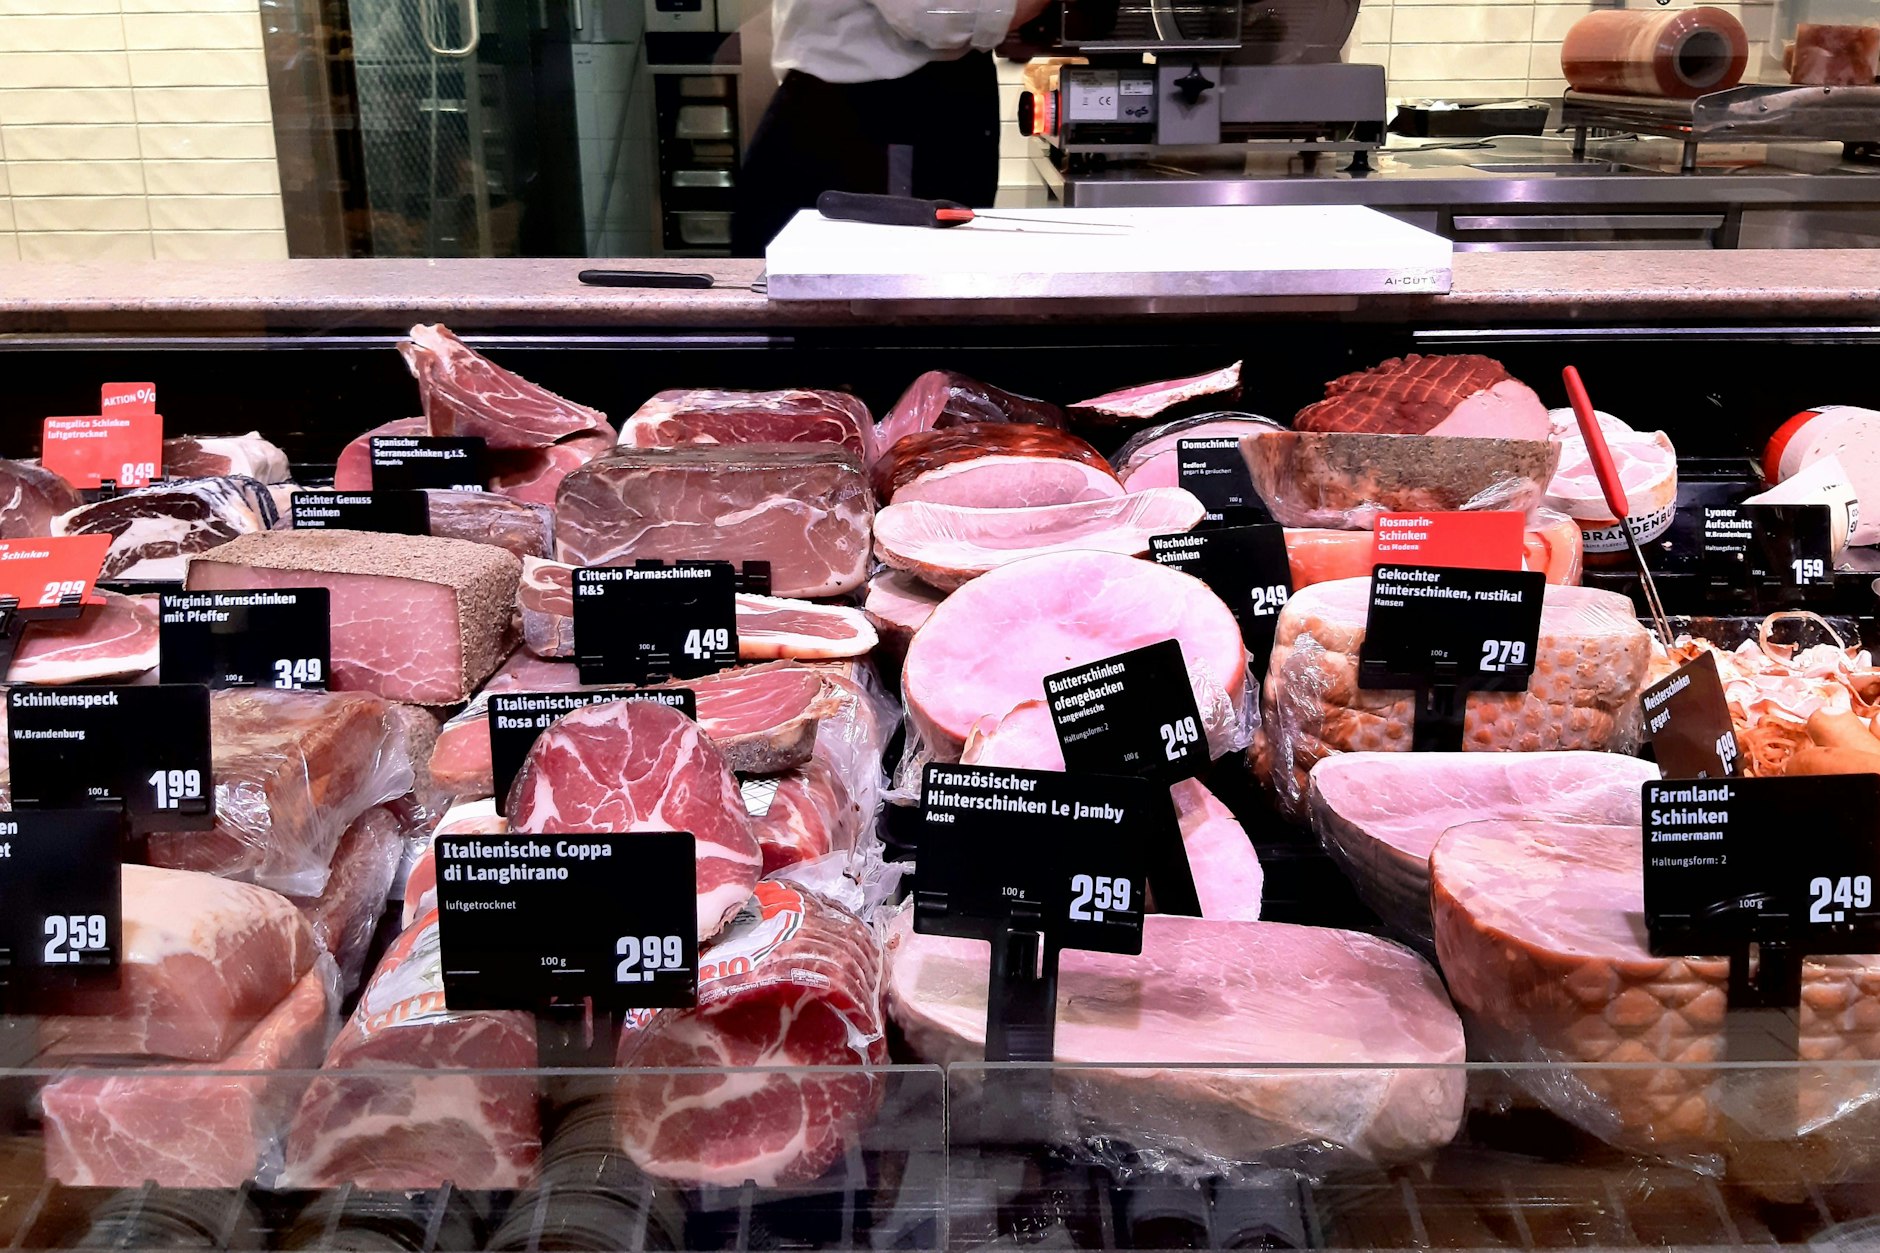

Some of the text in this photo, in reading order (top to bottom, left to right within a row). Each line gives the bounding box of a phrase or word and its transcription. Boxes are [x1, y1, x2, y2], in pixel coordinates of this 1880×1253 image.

[104, 394, 136, 406] AKTION
[48, 419, 130, 431] Mangalica Schinken
[374, 438, 419, 448] Spanischer
[374, 449, 443, 458] Serranoschinken
[122, 463, 154, 485] 8.49
[295, 495, 372, 504] Leichter Genuss
[296, 507, 340, 517] Schinken
[1704, 508, 1737, 518] Lyoner
[1380, 517, 1433, 527] Rosmarin-
[1705, 519, 1752, 528] Aufschnitt
[1379, 530, 1427, 540] Schinken
[1154, 536, 1208, 550] Wacholder-
[2, 551, 50, 560] Schinken
[1156, 550, 1200, 563] Schinken
[579, 568, 711, 581] Citterio Parmaschinken
[1378, 568, 1440, 582] Gekochter
[1791, 558, 1824, 585] 1.59
[40, 580, 86, 604] 2.99
[579, 585, 604, 595] R&S
[1376, 584, 1522, 602] Hinterschinken, rustikal
[164, 593, 296, 609] Virginia Kernschinken
[1252, 584, 1288, 616] 2.49
[1375, 598, 1403, 606] Hansen
[164, 610, 229, 623] mit Pfeffer
[684, 628, 730, 660] 4.49
[1480, 640, 1526, 672] 2.79
[274, 658, 322, 689] 3.49
[1049, 662, 1125, 694] Butterschinken
[13, 691, 118, 708] Schinkenspeck
[1054, 680, 1124, 712] ofengebacken
[1644, 674, 1690, 711] Meisterschinken
[496, 697, 587, 711] Italienischer
[498, 716, 532, 728] Rosa
[536, 715, 550, 728] di
[1650, 708, 1670, 733] gegart
[14, 729, 85, 740] W.Brandenburg
[1064, 722, 1110, 744] Haltungsform: 2
[1160, 716, 1198, 760] 2.49
[1123, 752, 1134, 761] 100
[1716, 731, 1737, 775] 1.99
[928, 768, 1037, 791] Französischer
[88, 787, 102, 796] 100
[148, 769, 201, 809] 1.99
[1651, 785, 1736, 803] Farmland-
[928, 790, 1125, 824] Hinterschinken Le Jamby
[926, 811, 954, 823] Aoste
[1651, 808, 1729, 825] Schinken
[1651, 830, 1724, 842] Zimmermann
[443, 841, 612, 861] Italienische Coppa
[1651, 855, 1727, 868] Haltungsform: 2
[443, 864, 569, 884] di Langhirano
[1001, 886, 1017, 896] 100
[1069, 874, 1131, 922] 2.59
[445, 900, 517, 912] luftgetrocknet
[1739, 898, 1756, 909] 100
[1810, 876, 1872, 922] 2.49
[44, 915, 106, 963] 2.59
[540, 957, 557, 967] 100
[615, 936, 683, 983] 2.99
